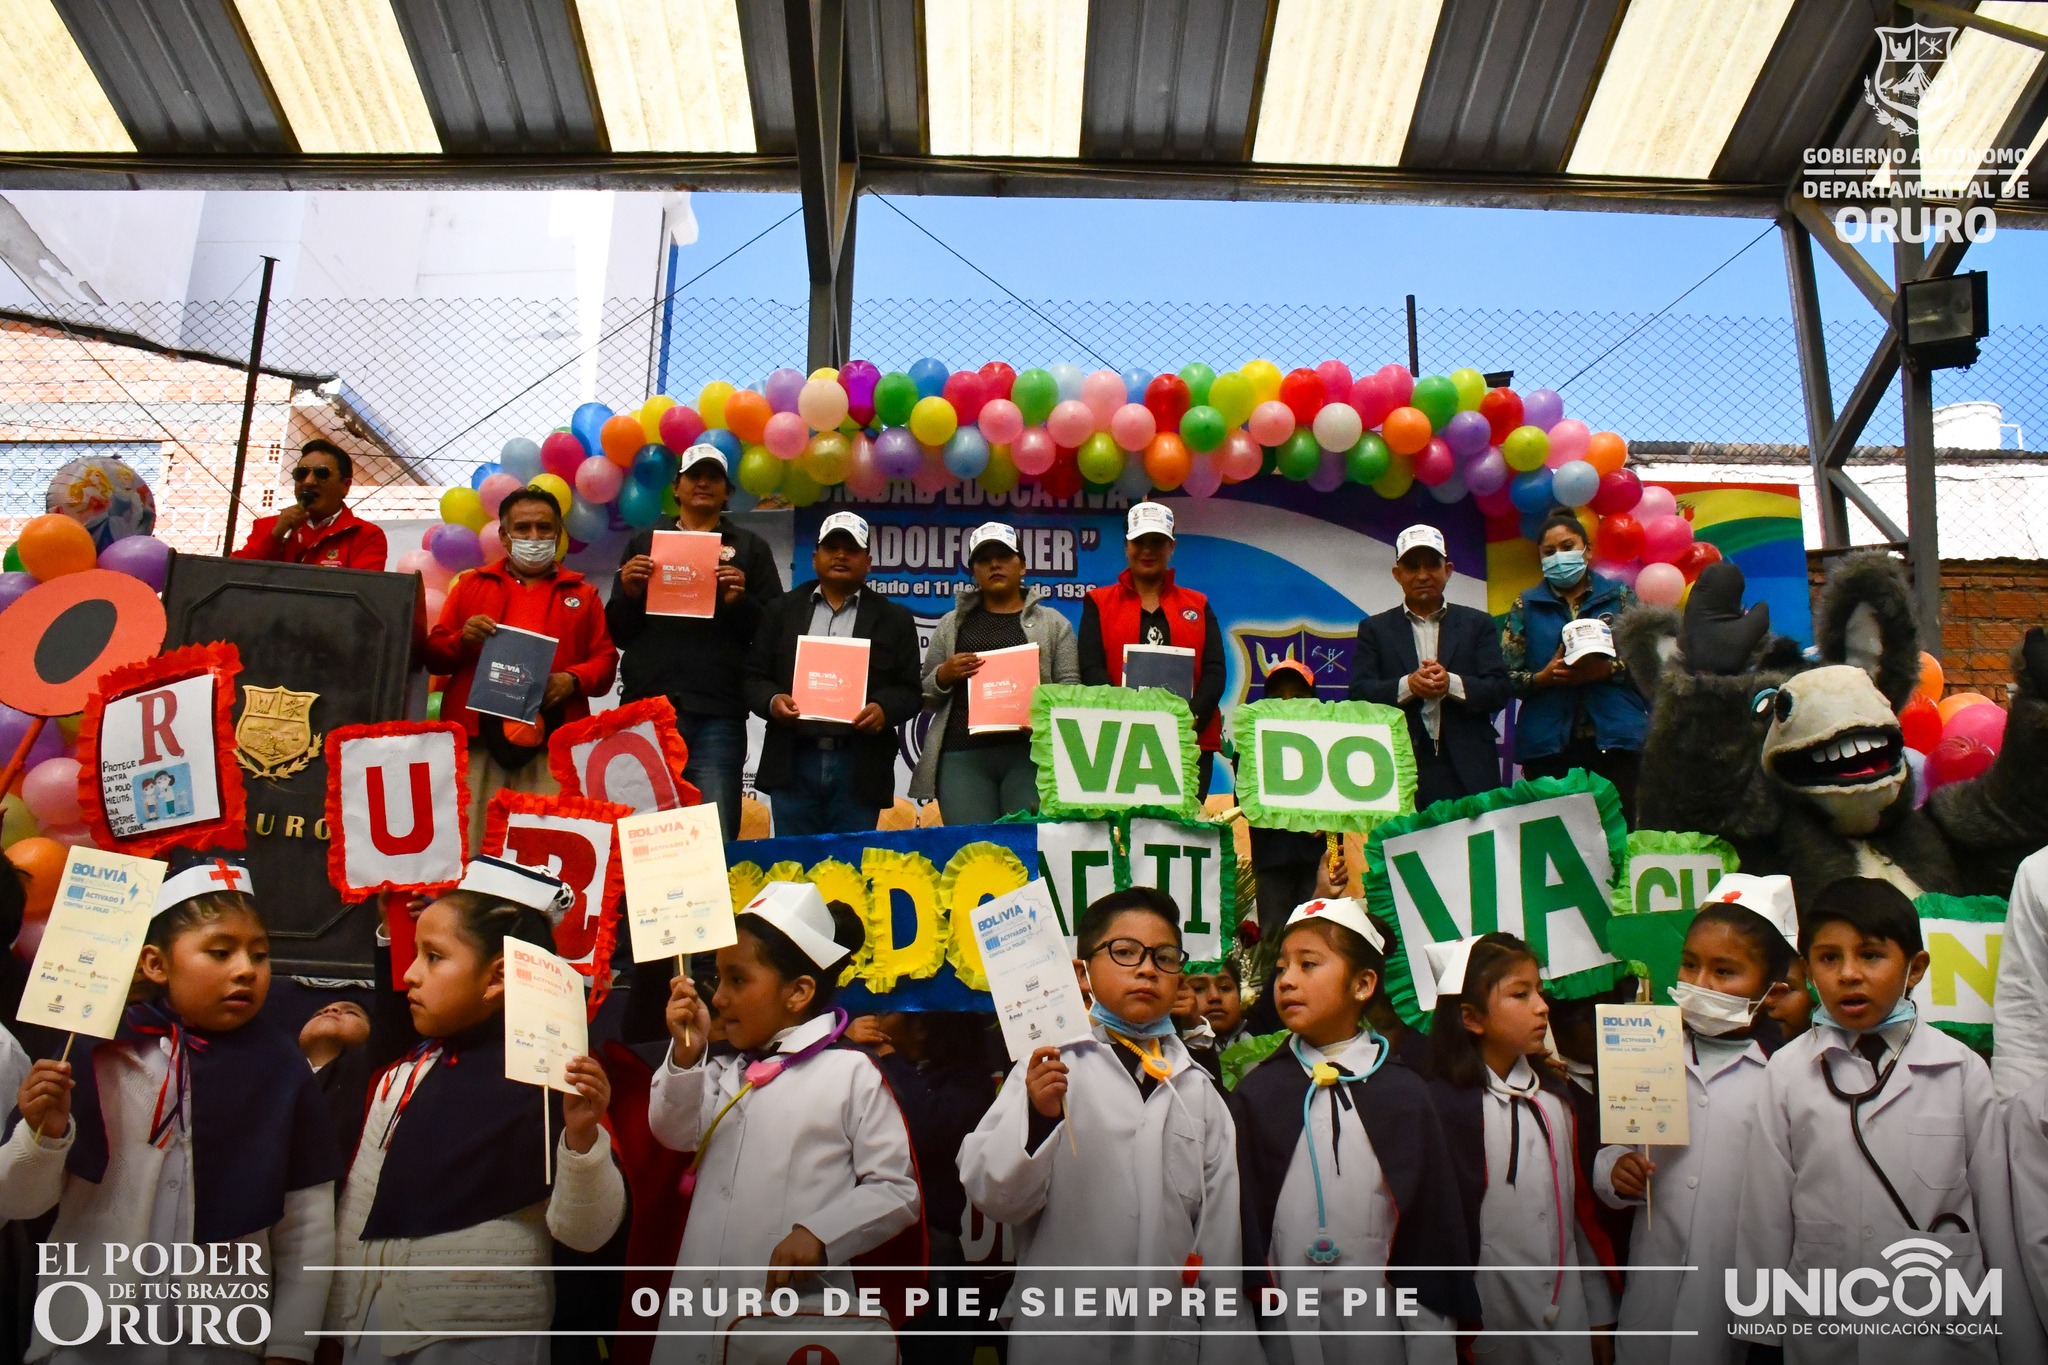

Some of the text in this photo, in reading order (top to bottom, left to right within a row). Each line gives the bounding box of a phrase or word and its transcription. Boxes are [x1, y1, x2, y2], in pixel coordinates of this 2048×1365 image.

[913, 581, 930, 594] el
[933, 581, 950, 595] 11
[135, 689, 185, 766] R
[1056, 717, 1181, 796] VA
[103, 773, 128, 783] CONTRA
[104, 785, 112, 794] LA
[1261, 729, 1395, 803] DO
[255, 812, 331, 841] URO
[366, 761, 435, 857] U
[1144, 843, 1212, 935] TI
[1392, 815, 1614, 969] VA
